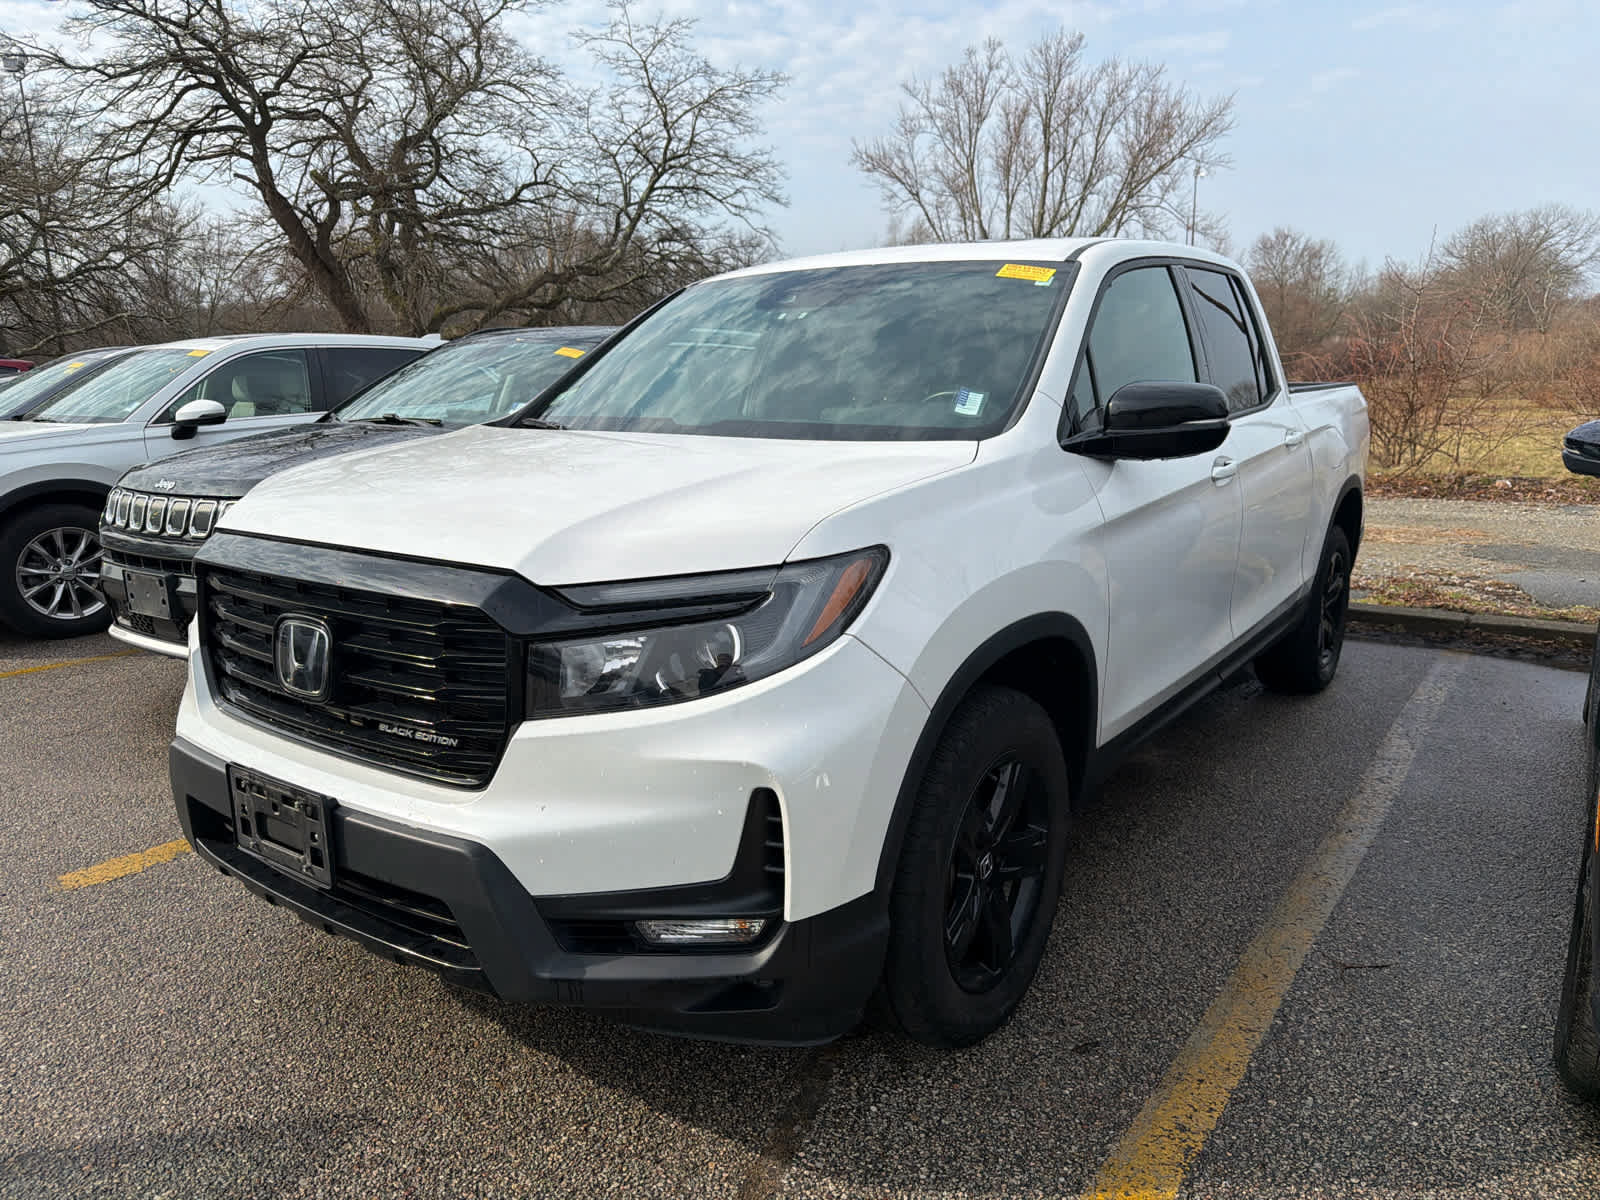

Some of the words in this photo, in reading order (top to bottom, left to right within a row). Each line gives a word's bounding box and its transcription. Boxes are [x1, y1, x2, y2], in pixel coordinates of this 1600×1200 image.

[154, 478, 176, 490] Jeep
[378, 722, 414, 738] BLACK
[415, 730, 458, 747] EDITION
